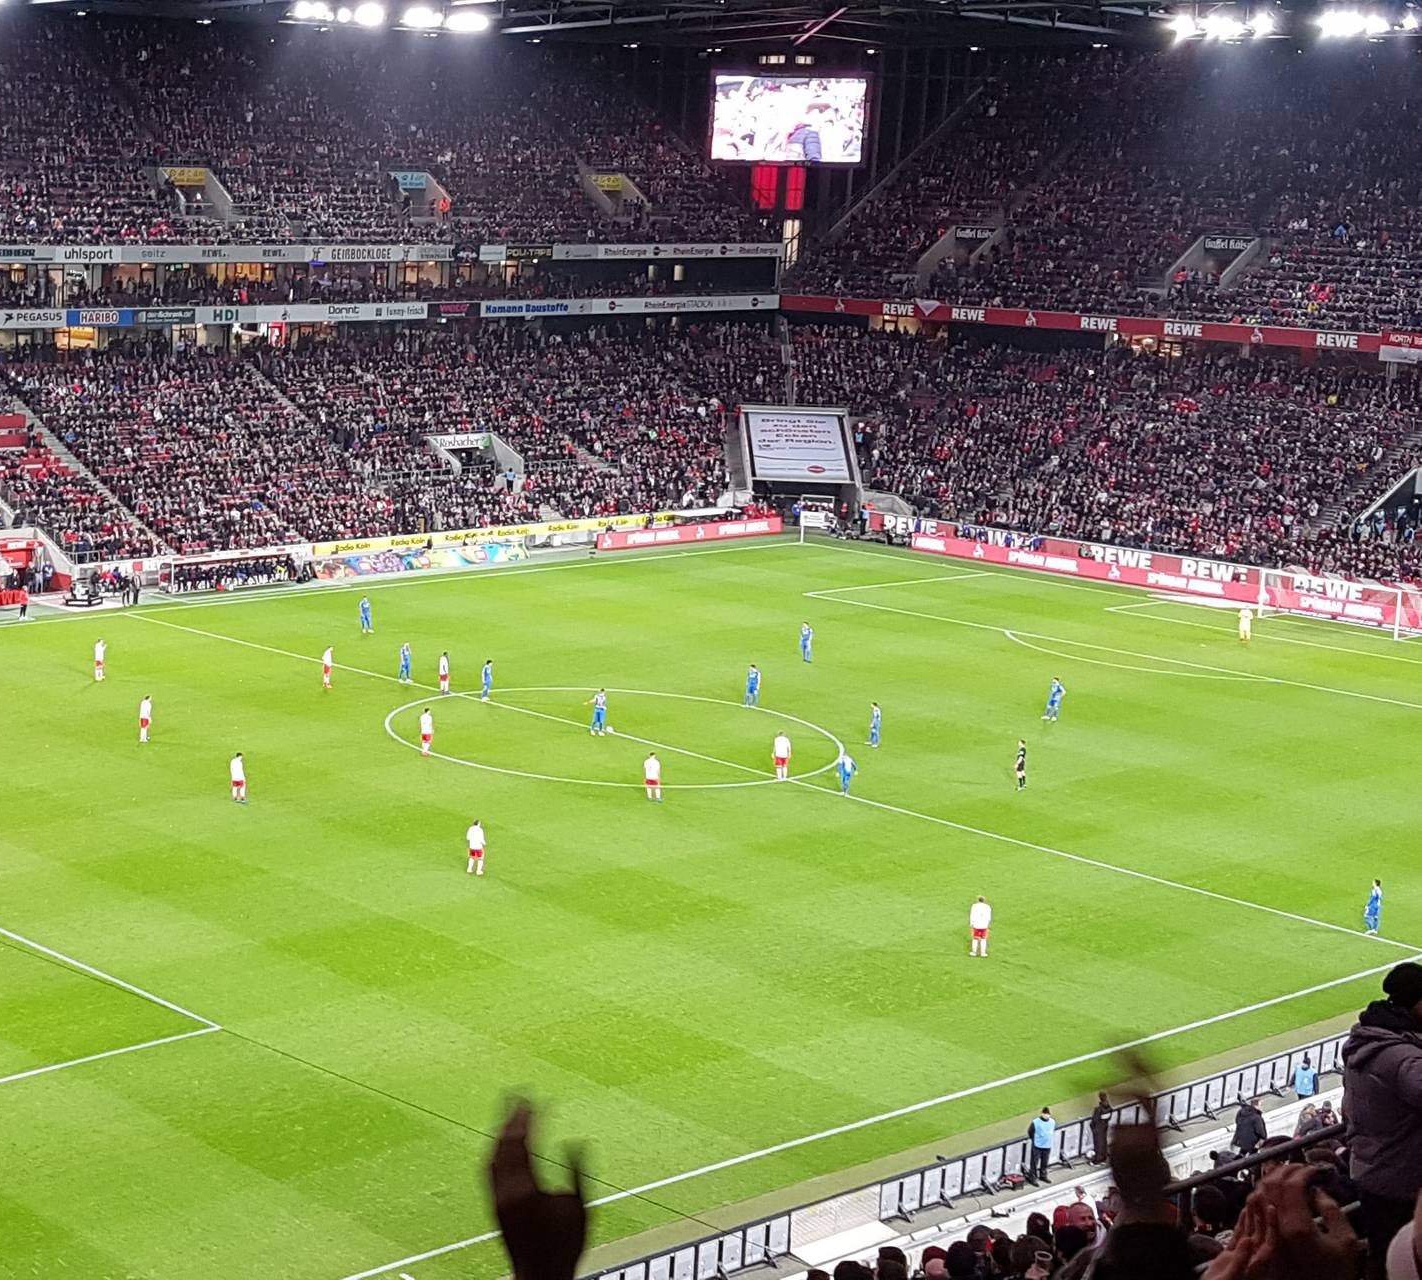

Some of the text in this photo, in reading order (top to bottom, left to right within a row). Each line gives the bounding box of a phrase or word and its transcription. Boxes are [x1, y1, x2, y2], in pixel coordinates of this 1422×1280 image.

[64, 247, 114, 262] uhlsport
[604, 246, 647, 257] RheinEnergie
[673, 246, 714, 257] RheinEnergie
[485, 302, 569, 314] Hamann Baustoffe
[882, 303, 915, 317] REWE
[951, 307, 986, 322] REWE
[16, 312, 62, 322] PEGASUS
[80, 311, 119, 324] HARIBO
[213, 309, 239, 322] HDI
[1080, 316, 1117, 331] REWE
[1163, 322, 1203, 338] REWE
[1316, 333, 1358, 349] REWE
[439, 436, 479, 448] Rosbacher
[1090, 544, 1152, 570] REWE
[1181, 558, 1248, 586] REWE
[1294, 574, 1363, 602] REWE
